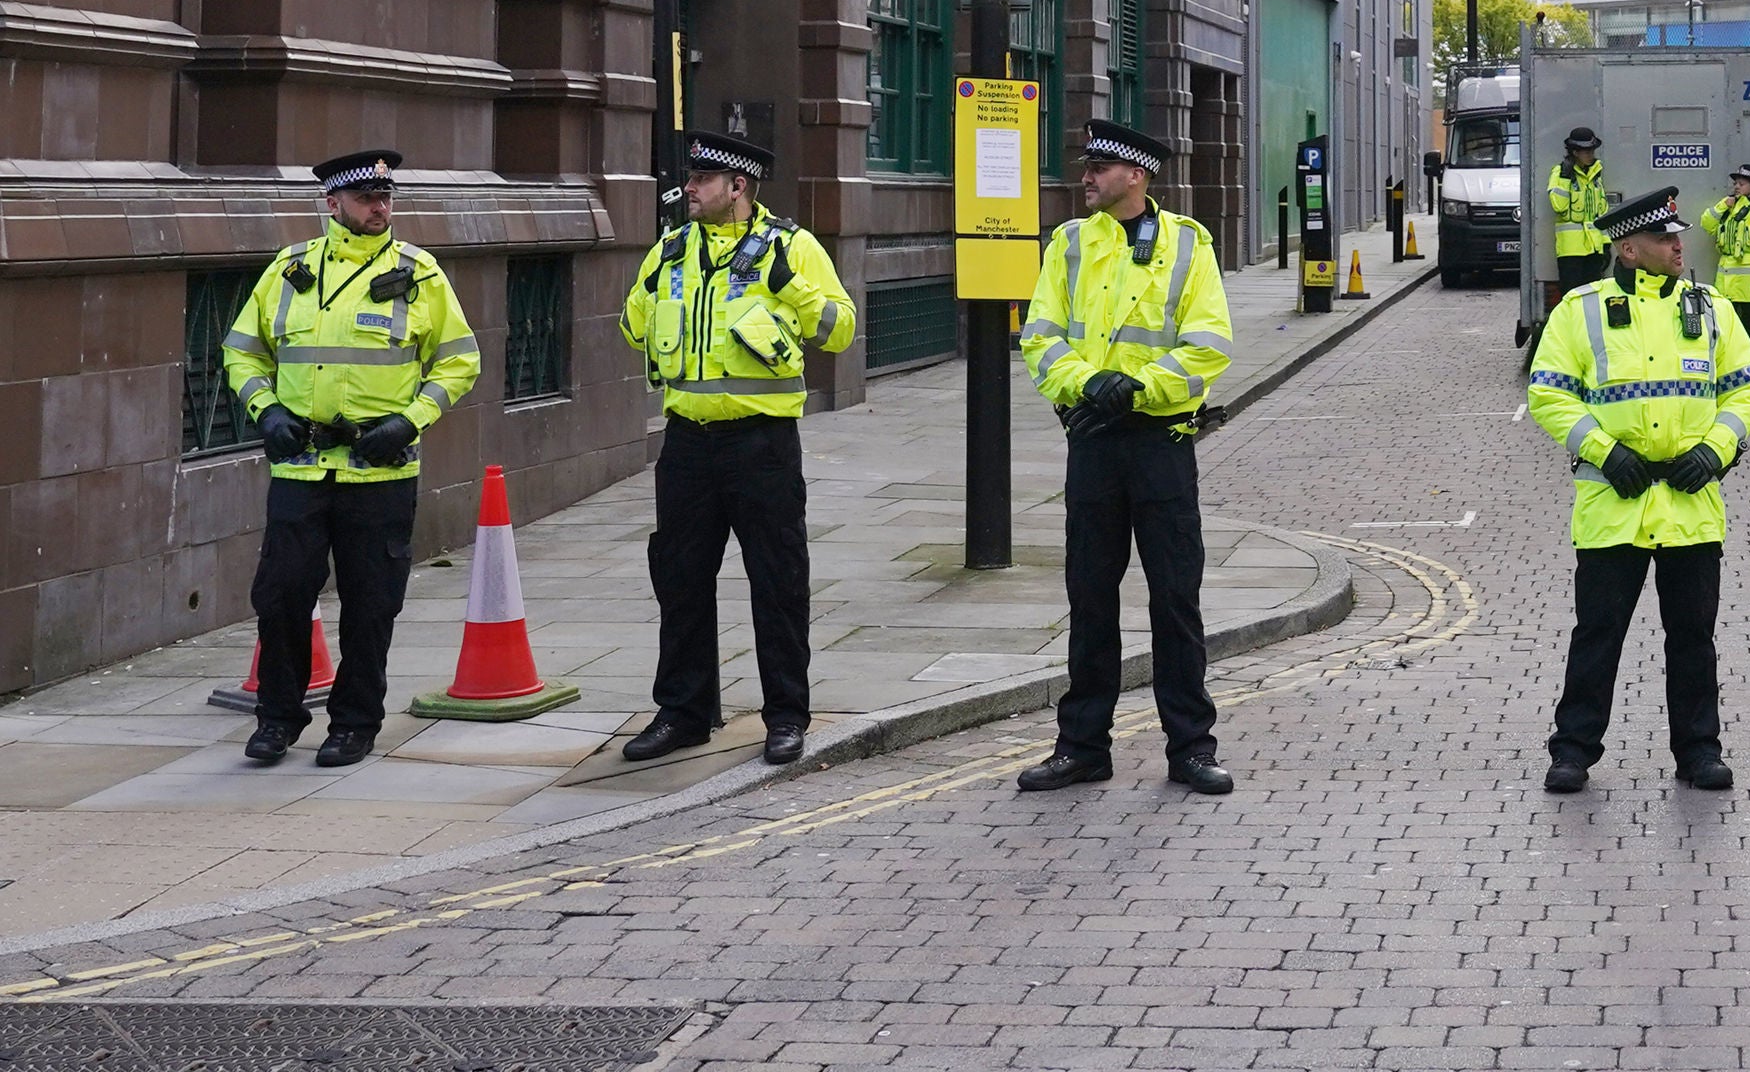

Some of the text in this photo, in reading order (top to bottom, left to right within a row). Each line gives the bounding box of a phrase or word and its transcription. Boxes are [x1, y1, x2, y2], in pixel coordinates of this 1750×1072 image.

[984, 82, 1013, 91] Parking
[977, 90, 1020, 99] Suspension
[991, 106, 1018, 115] loading
[991, 115, 1018, 124] parking
[1658, 146, 1704, 156] POLICE
[1309, 150, 1319, 166] P
[1654, 158, 1708, 167] CORDON
[985, 217, 1010, 225] City of
[976, 225, 1019, 233] Manchester
[358, 317, 391, 327] POLICE
[1684, 360, 1709, 371] POLICE
